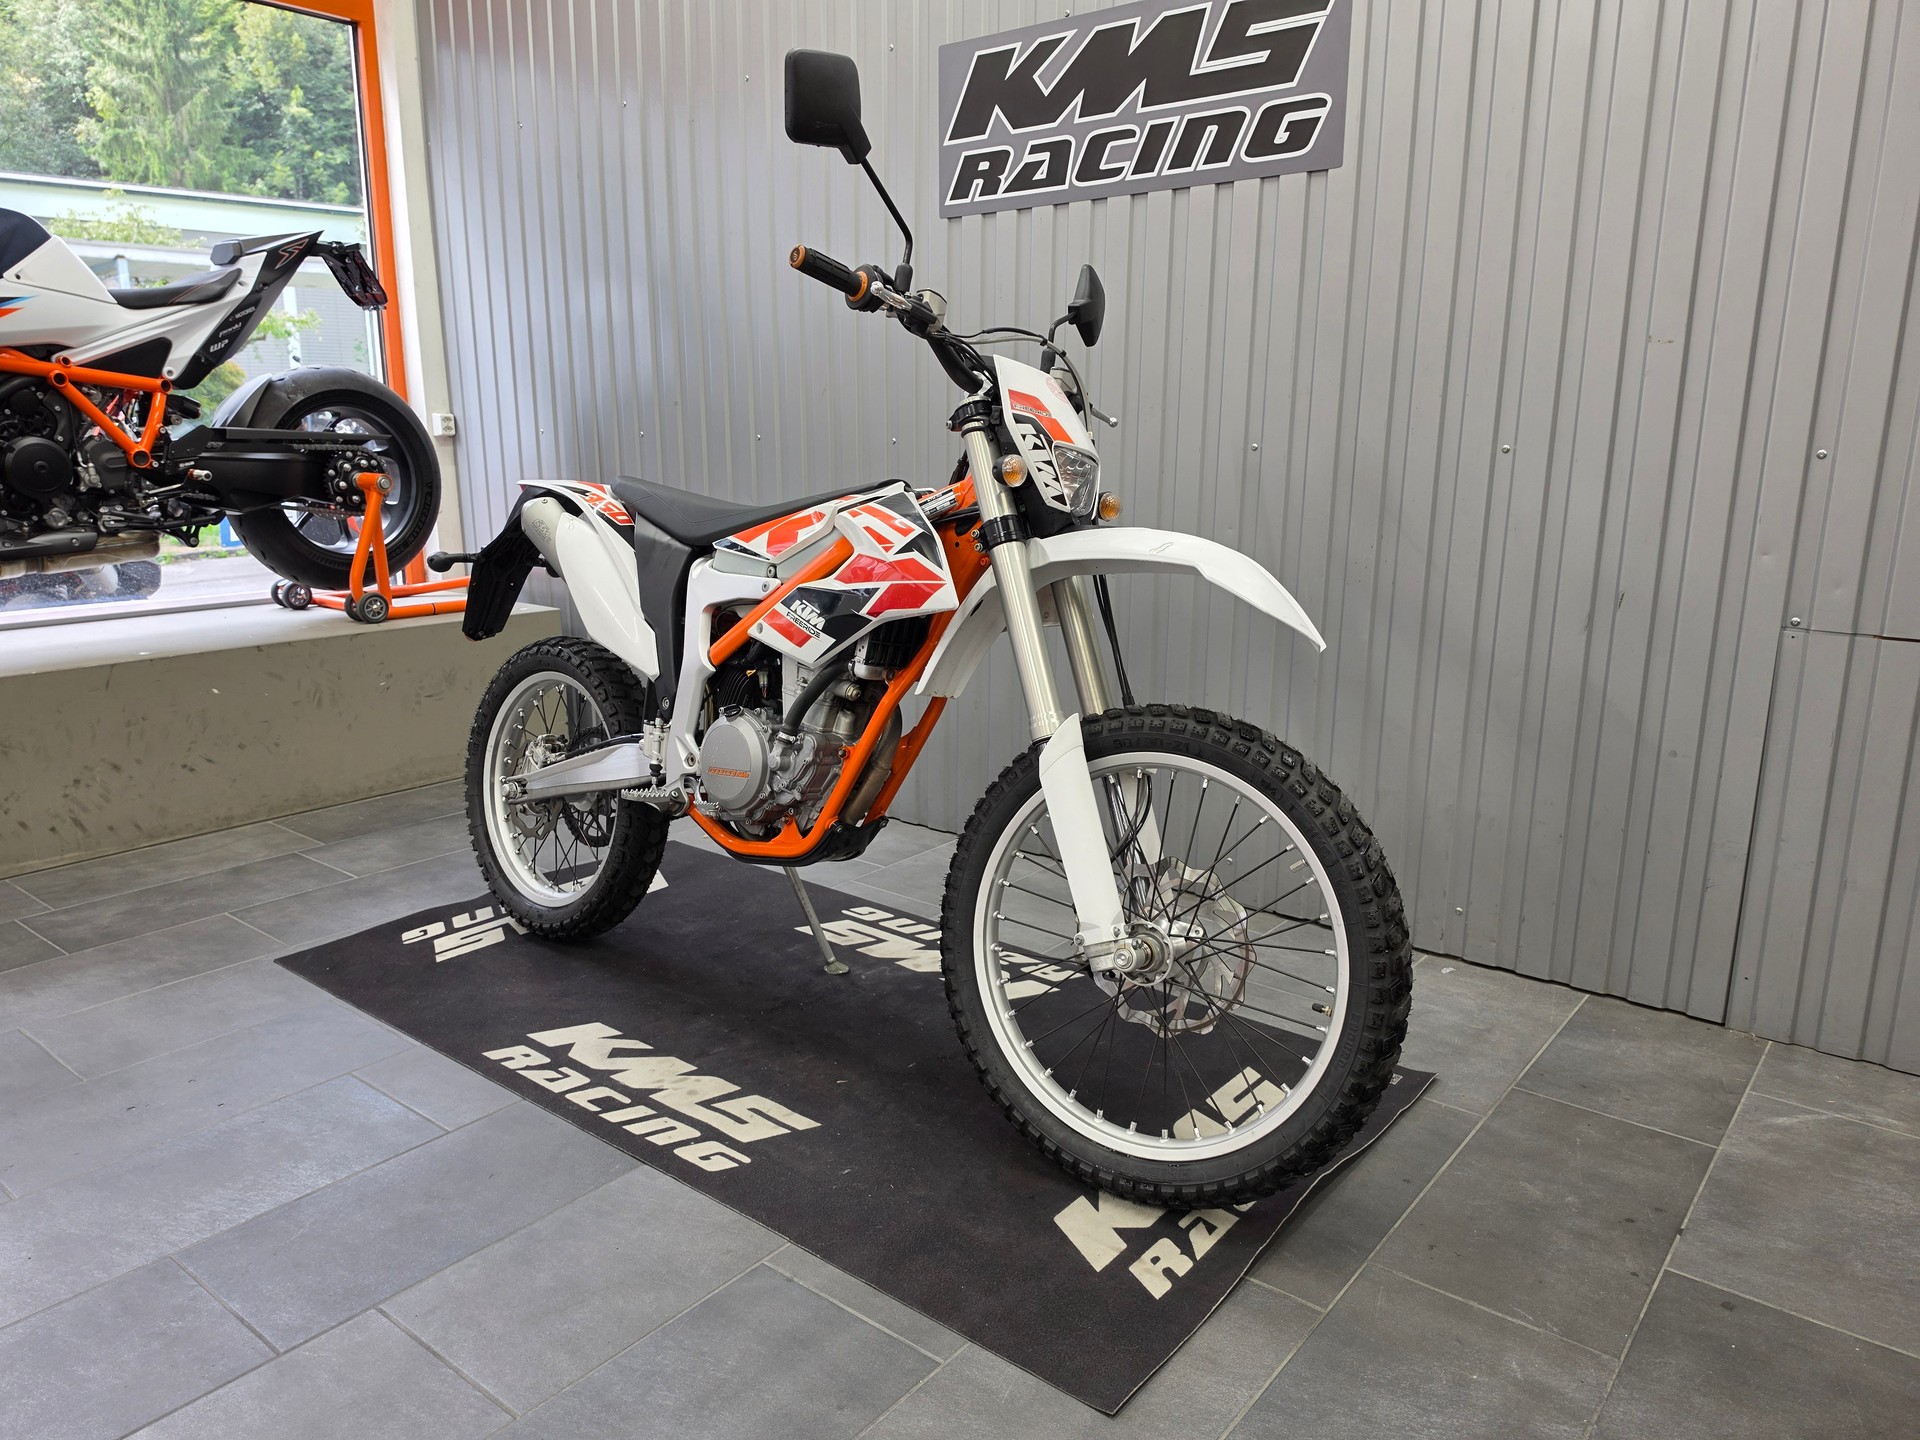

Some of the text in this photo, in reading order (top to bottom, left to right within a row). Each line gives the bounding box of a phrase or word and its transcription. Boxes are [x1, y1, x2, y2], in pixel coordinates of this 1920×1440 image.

[943, 0, 1334, 145] KMS
[945, 93, 1332, 205] RACING
[210, 339, 229, 353] WP
[1016, 423, 1068, 500] KTM
[581, 492, 635, 525] 350
[786, 611, 821, 639] FREERIDE
[790, 599, 826, 631] KTM
[482, 1045, 752, 1172] RACING
[526, 1022, 822, 1142] KMS
